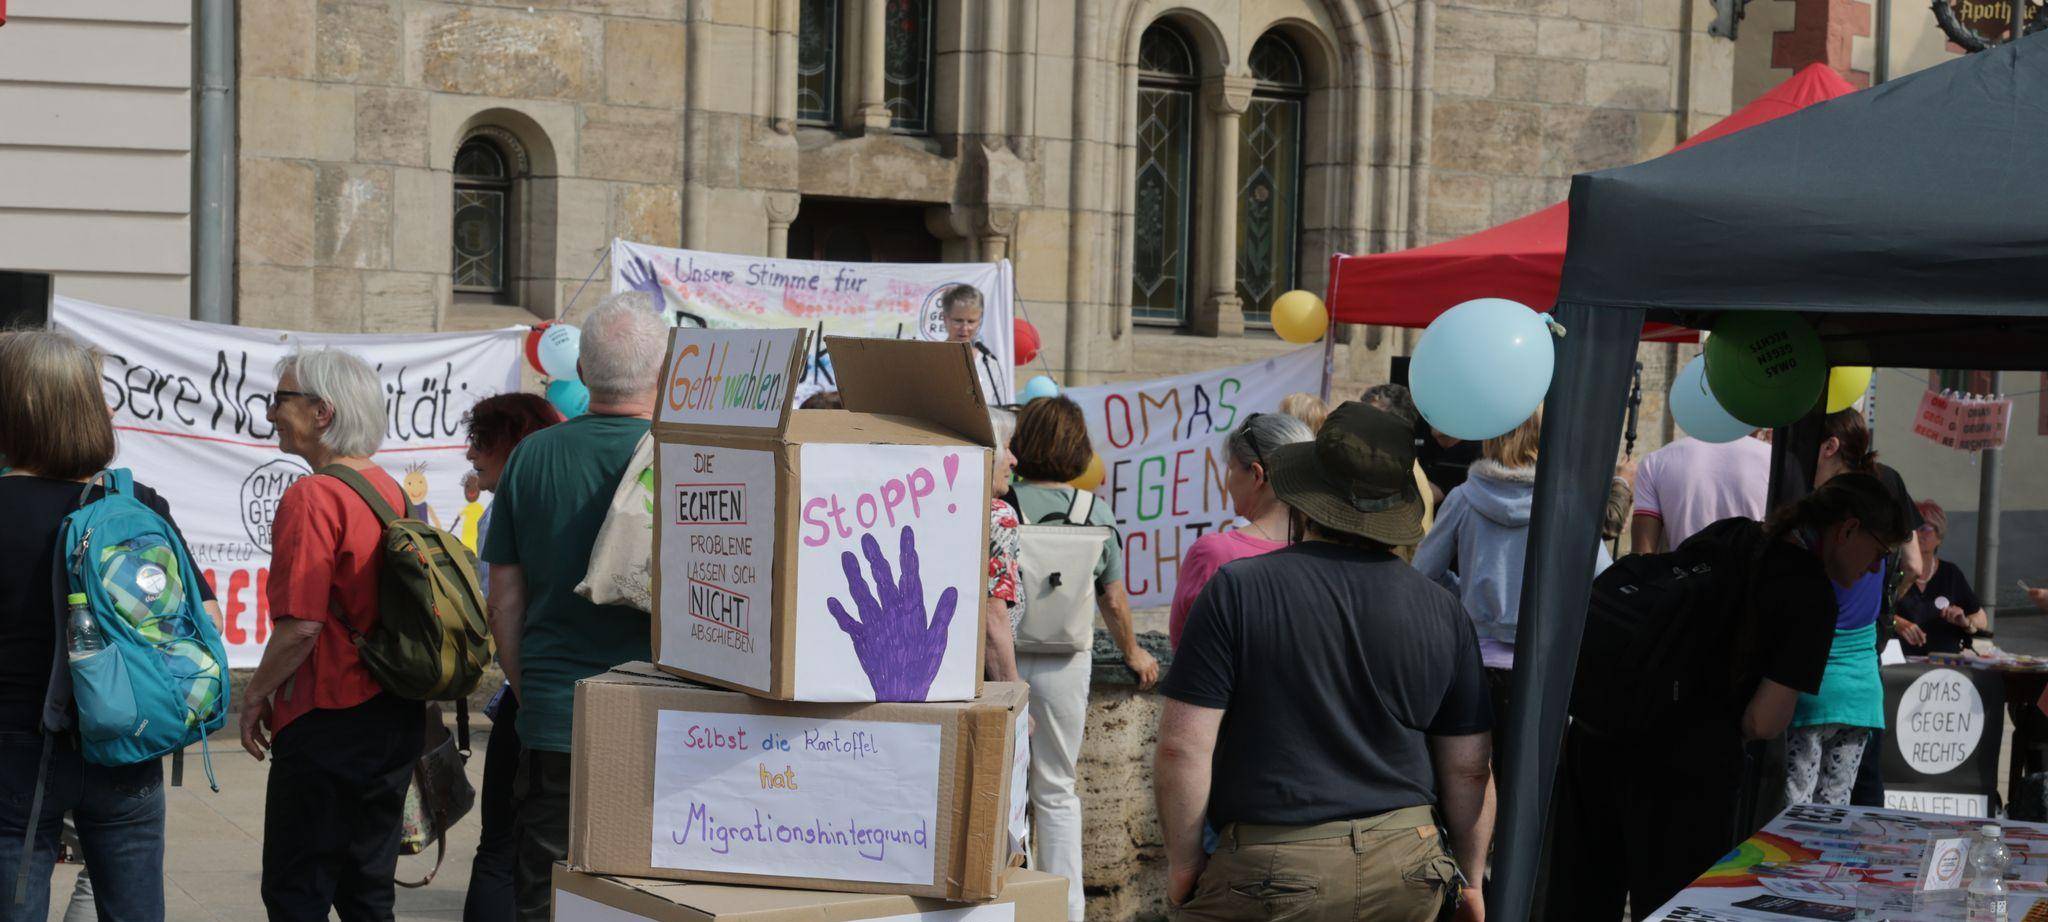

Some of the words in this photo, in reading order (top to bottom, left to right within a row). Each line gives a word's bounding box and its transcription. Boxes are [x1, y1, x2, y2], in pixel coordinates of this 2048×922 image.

[1961, 0, 2037, 24] Apothe
[674, 257, 734, 283] Unsere
[748, 263, 819, 290] Stimme
[835, 268, 868, 292] für
[101, 353, 202, 425] sere
[669, 339, 729, 411] Geht
[1105, 378, 1241, 448] OMAS
[693, 452, 715, 473] DIE
[803, 453, 960, 547] Stopp!
[1100, 446, 1230, 524] EGEN
[679, 490, 742, 522] ECHTEN
[190, 542, 254, 563] AALFELD
[690, 534, 753, 556] PROBLEME
[687, 562, 726, 582] LASSEN
[732, 565, 756, 584] SICH
[691, 585, 744, 628] NICHT
[691, 623, 755, 654] ABSCHIEBEN
[1918, 681, 1961, 702] OMAS
[1911, 712, 1972, 733] GEGEN
[684, 725, 748, 750] Selbst
[762, 733, 791, 752] die
[804, 728, 878, 759] Kartoffel
[1912, 742, 1966, 763] RECHTS
[759, 762, 798, 790] hat
[672, 802, 927, 861] Migrationshintergrund
